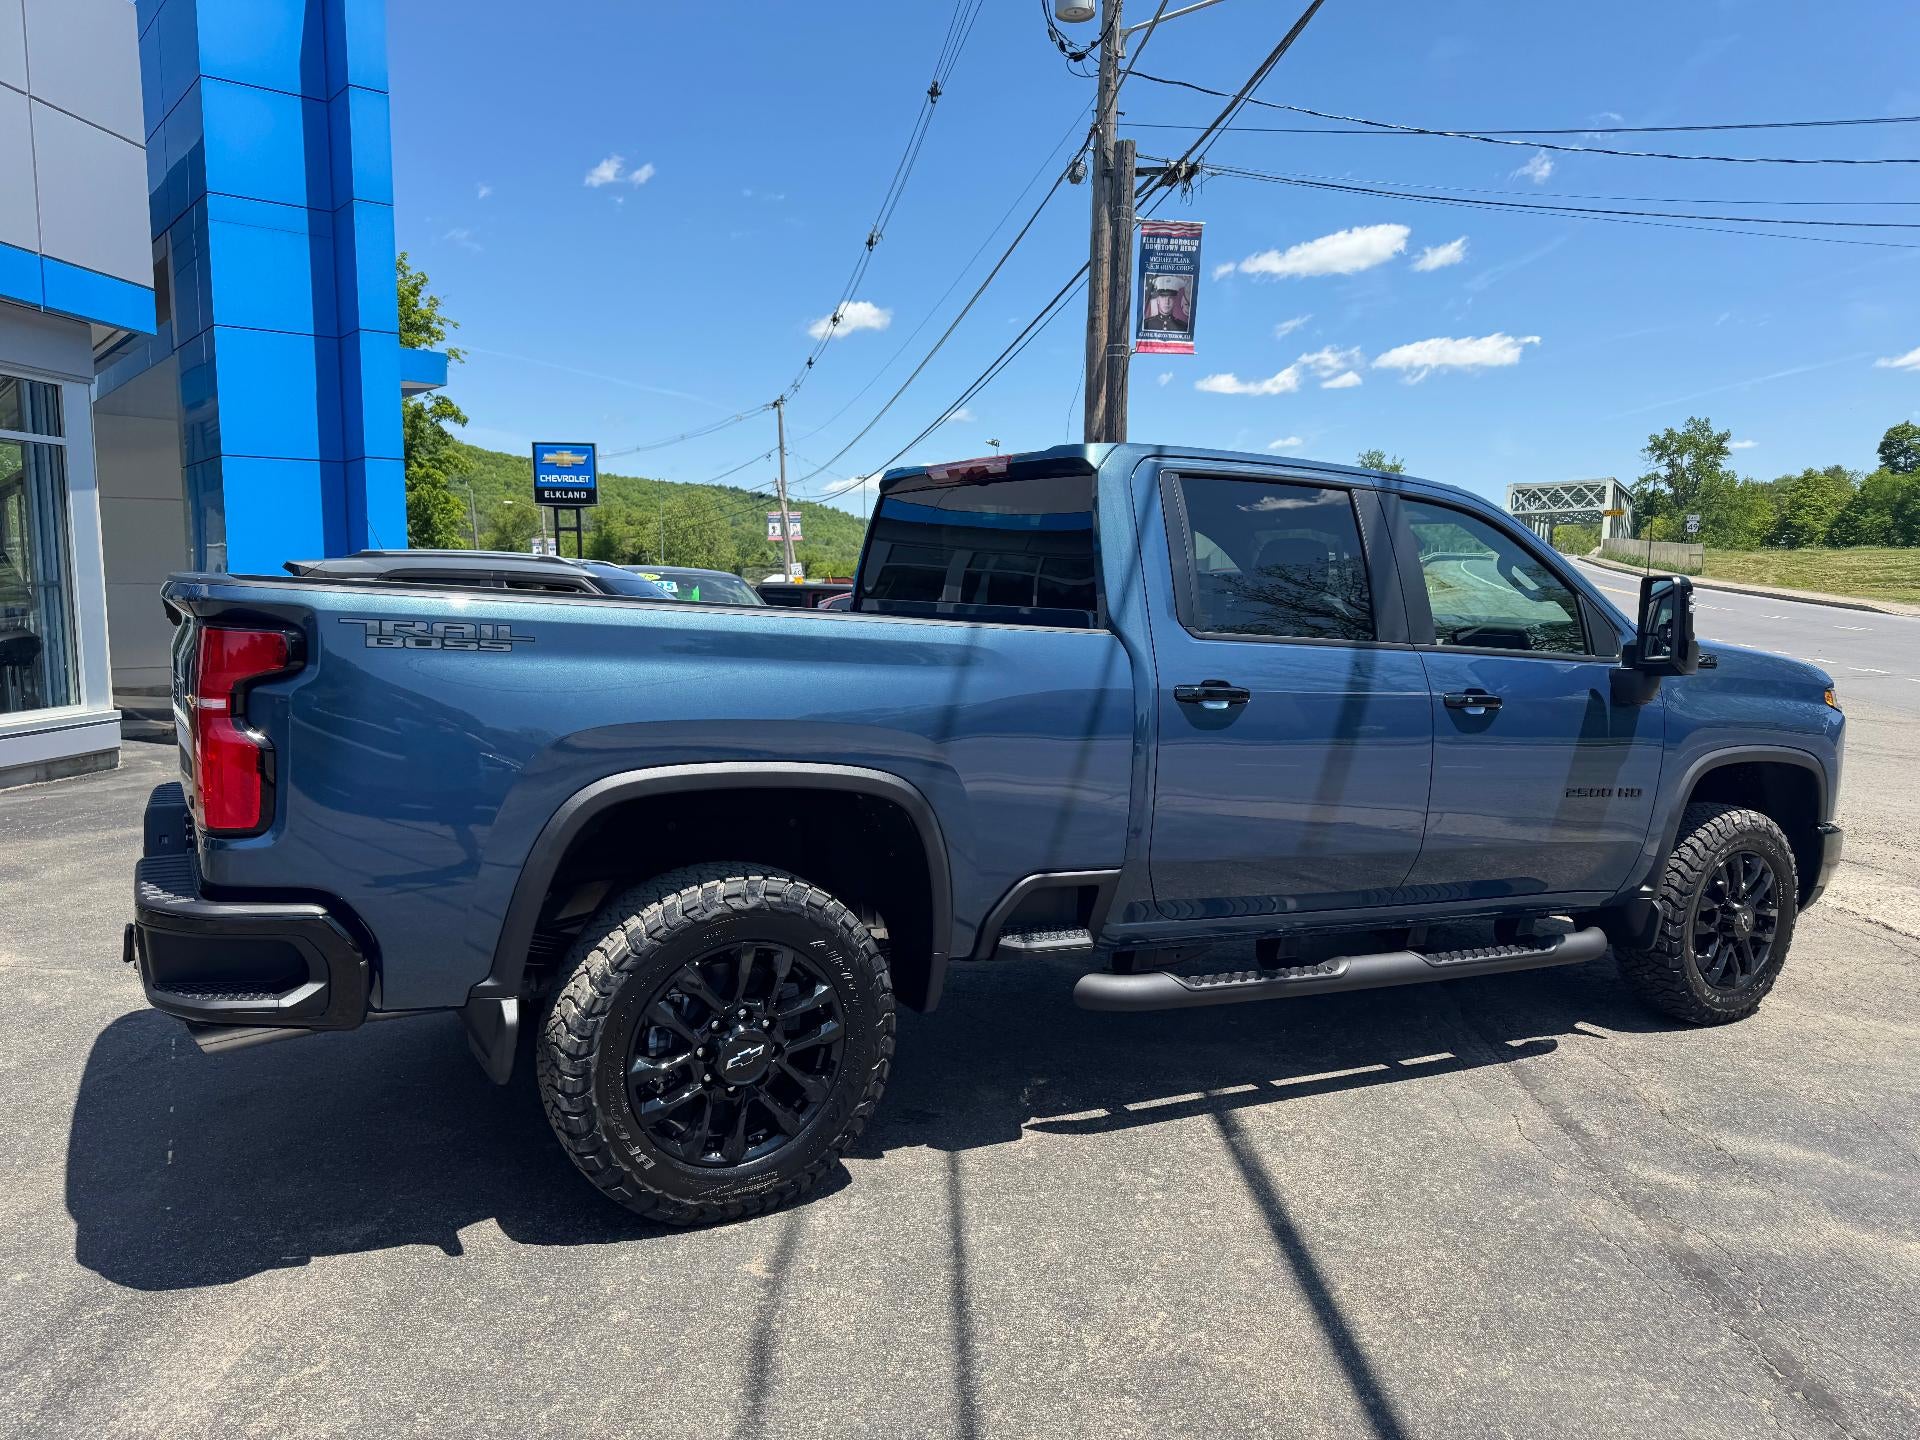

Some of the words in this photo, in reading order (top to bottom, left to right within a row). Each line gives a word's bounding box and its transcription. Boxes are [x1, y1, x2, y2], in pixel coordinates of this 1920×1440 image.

[540, 474, 590, 483] CHEVROLET
[544, 490, 587, 499] ELKLAND
[338, 617, 536, 643] TRAIL
[365, 634, 512, 652] BOSS
[1565, 787, 1612, 798] 2500
[1617, 787, 1643, 798] HD
